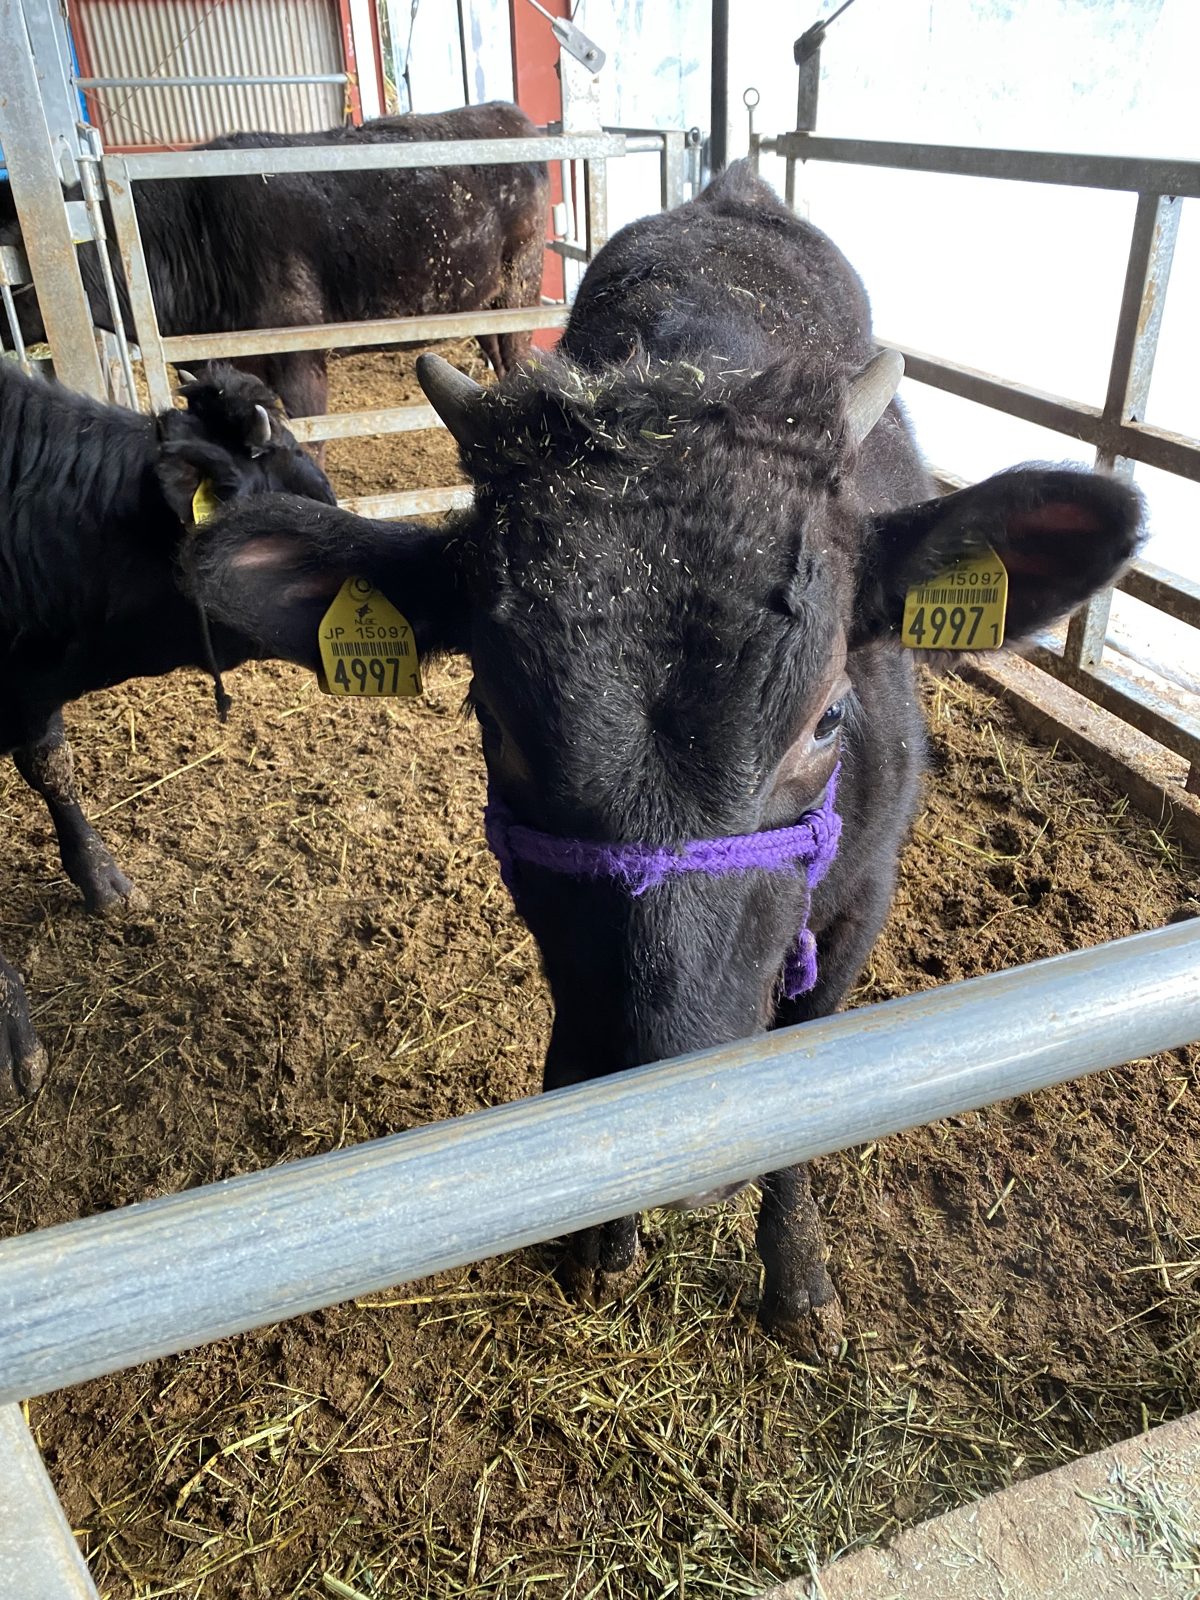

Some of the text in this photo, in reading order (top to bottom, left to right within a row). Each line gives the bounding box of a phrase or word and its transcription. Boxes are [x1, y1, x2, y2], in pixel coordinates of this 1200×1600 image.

[947, 572, 1003, 585] 15097
[324, 626, 408, 640] JP 15097
[908, 606, 999, 646] 4997 1
[334, 658, 420, 693] 4997 1
